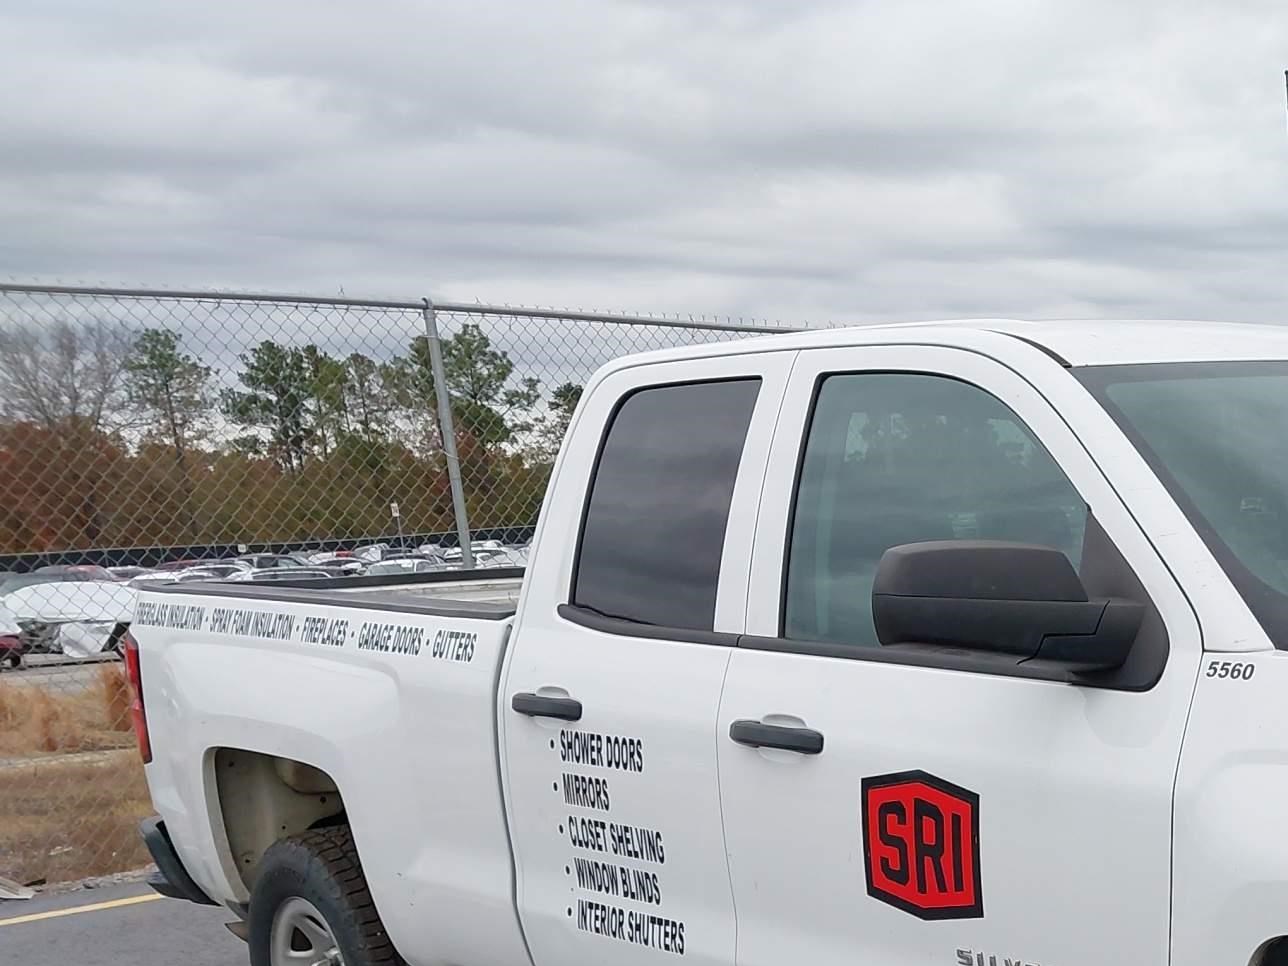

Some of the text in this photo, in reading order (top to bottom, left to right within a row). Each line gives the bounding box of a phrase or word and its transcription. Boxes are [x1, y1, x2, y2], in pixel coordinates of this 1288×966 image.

[210, 608, 234, 633] SPRAY
[230, 610, 252, 635] FOAM
[249, 611, 296, 640] INSULATION
[301, 617, 349, 646] FIREPLACES
[358, 622, 395, 652] GARAGE
[392, 626, 424, 656] DOORS
[432, 629, 478, 662] GUTTERS
[1206, 661, 1255, 680] 5560
[560, 729, 643, 772] SHOWER DOORS
[562, 773, 609, 811] MIRRORS
[568, 815, 665, 864] CLOSET SHELVING
[878, 797, 965, 895] SRI
[574, 857, 661, 905] WINDOW BLINDS
[577, 899, 685, 955] INTERIOR SHUTTERS
